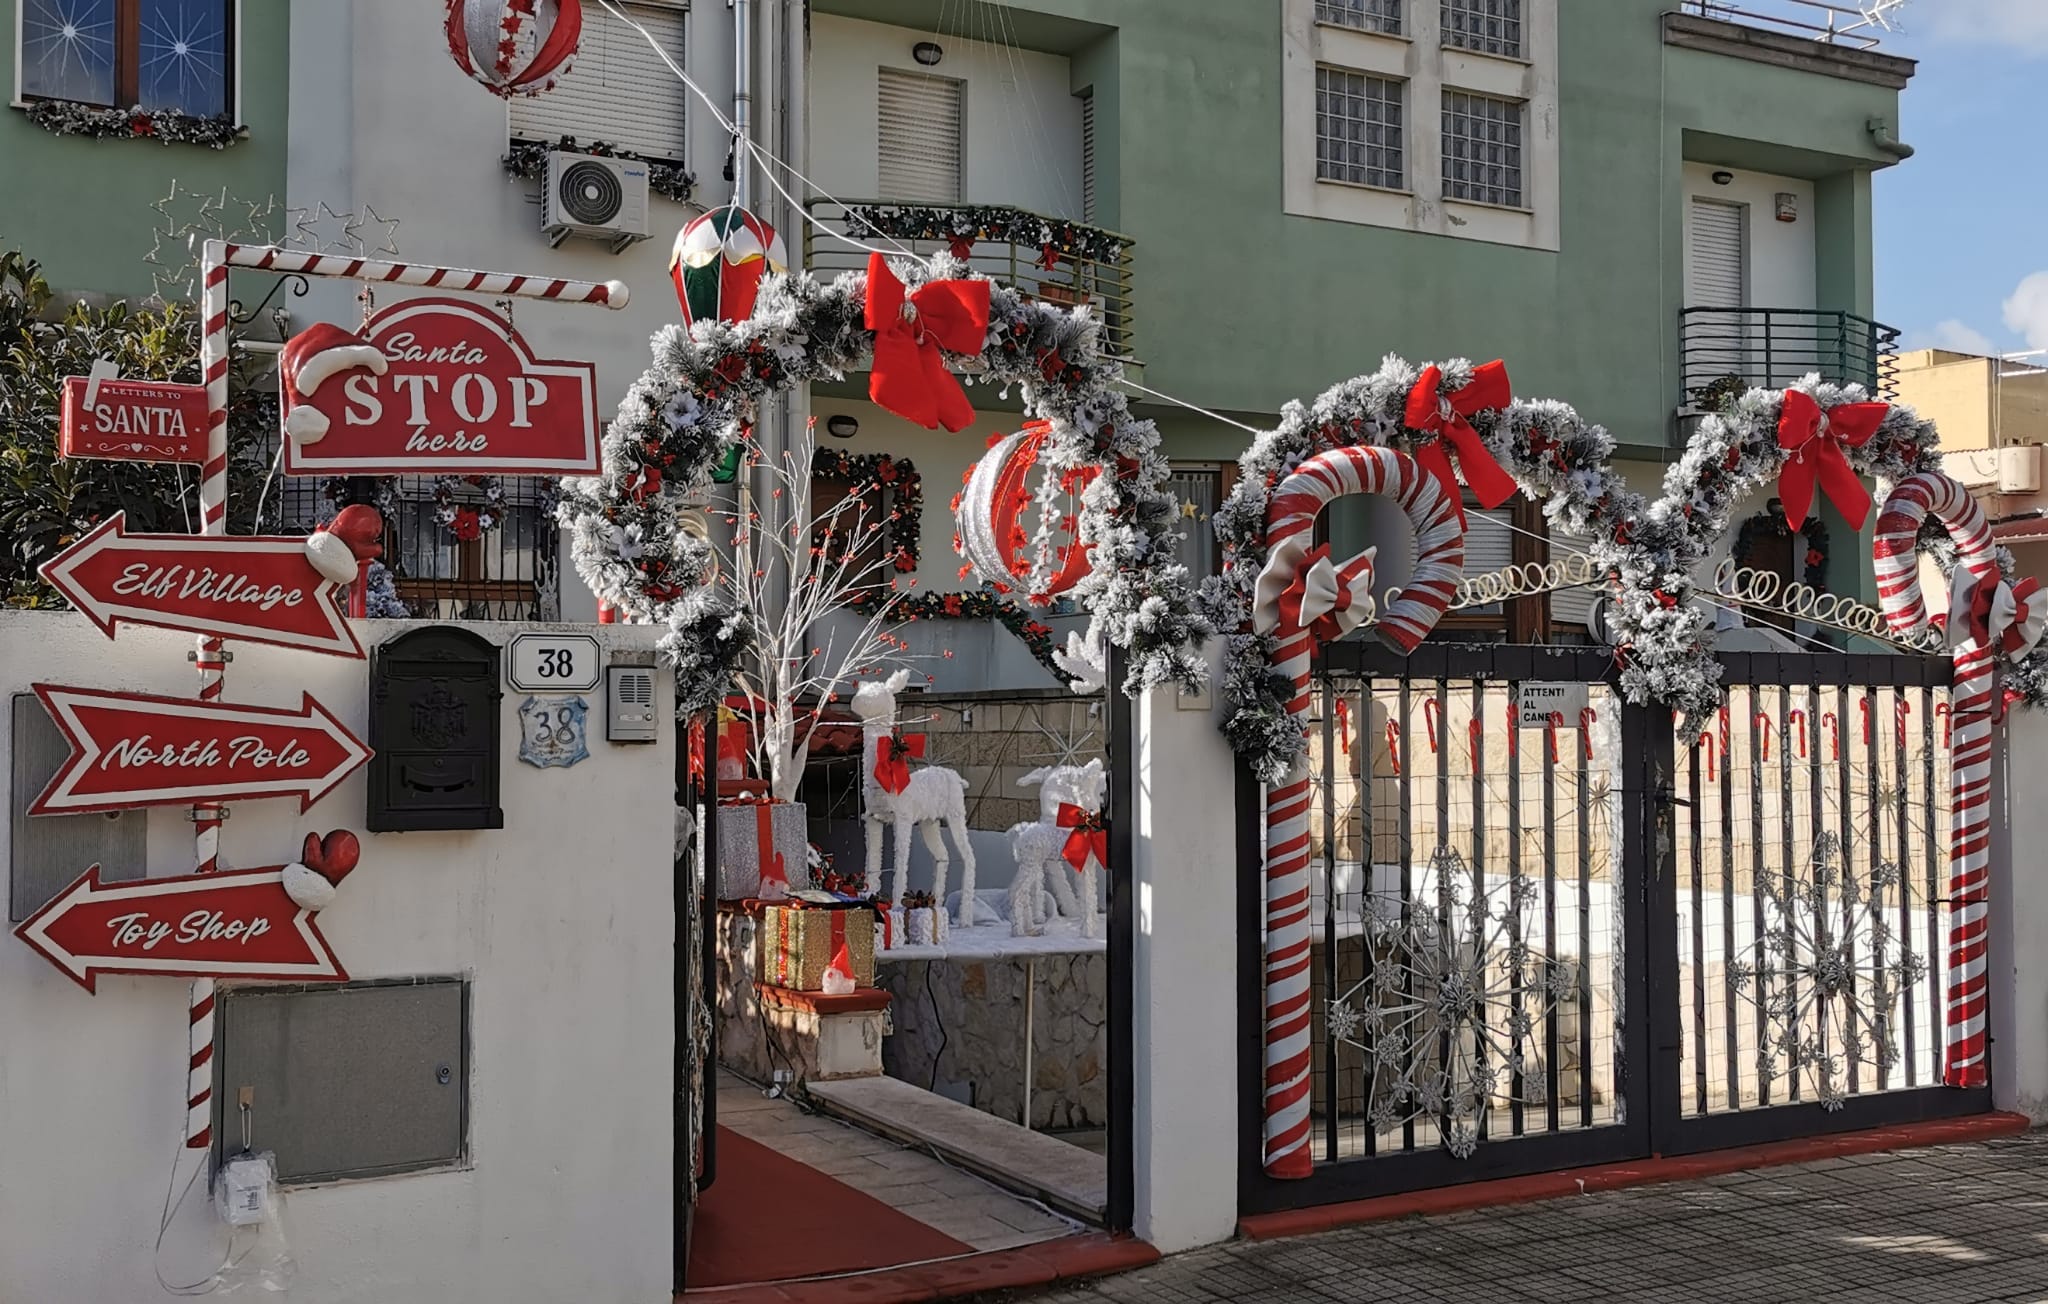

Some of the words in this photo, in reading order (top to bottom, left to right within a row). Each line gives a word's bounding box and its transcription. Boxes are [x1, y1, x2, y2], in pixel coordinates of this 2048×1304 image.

[382, 332, 488, 365] Santa
[111, 387, 164, 398] LETTERS
[168, 391, 182, 400] TO
[344, 373, 548, 428] STOP
[95, 404, 188, 438] SANTA
[405, 425, 489, 452] here
[112, 563, 184, 599] Elf
[178, 567, 304, 611] Village
[537, 649, 573, 678] 38
[1523, 700, 1536, 710] AL
[534, 706, 576, 745] 38
[100, 734, 222, 771] North
[228, 736, 311, 769] Pole
[106, 912, 173, 950] Toy
[175, 910, 271, 945] Shop
